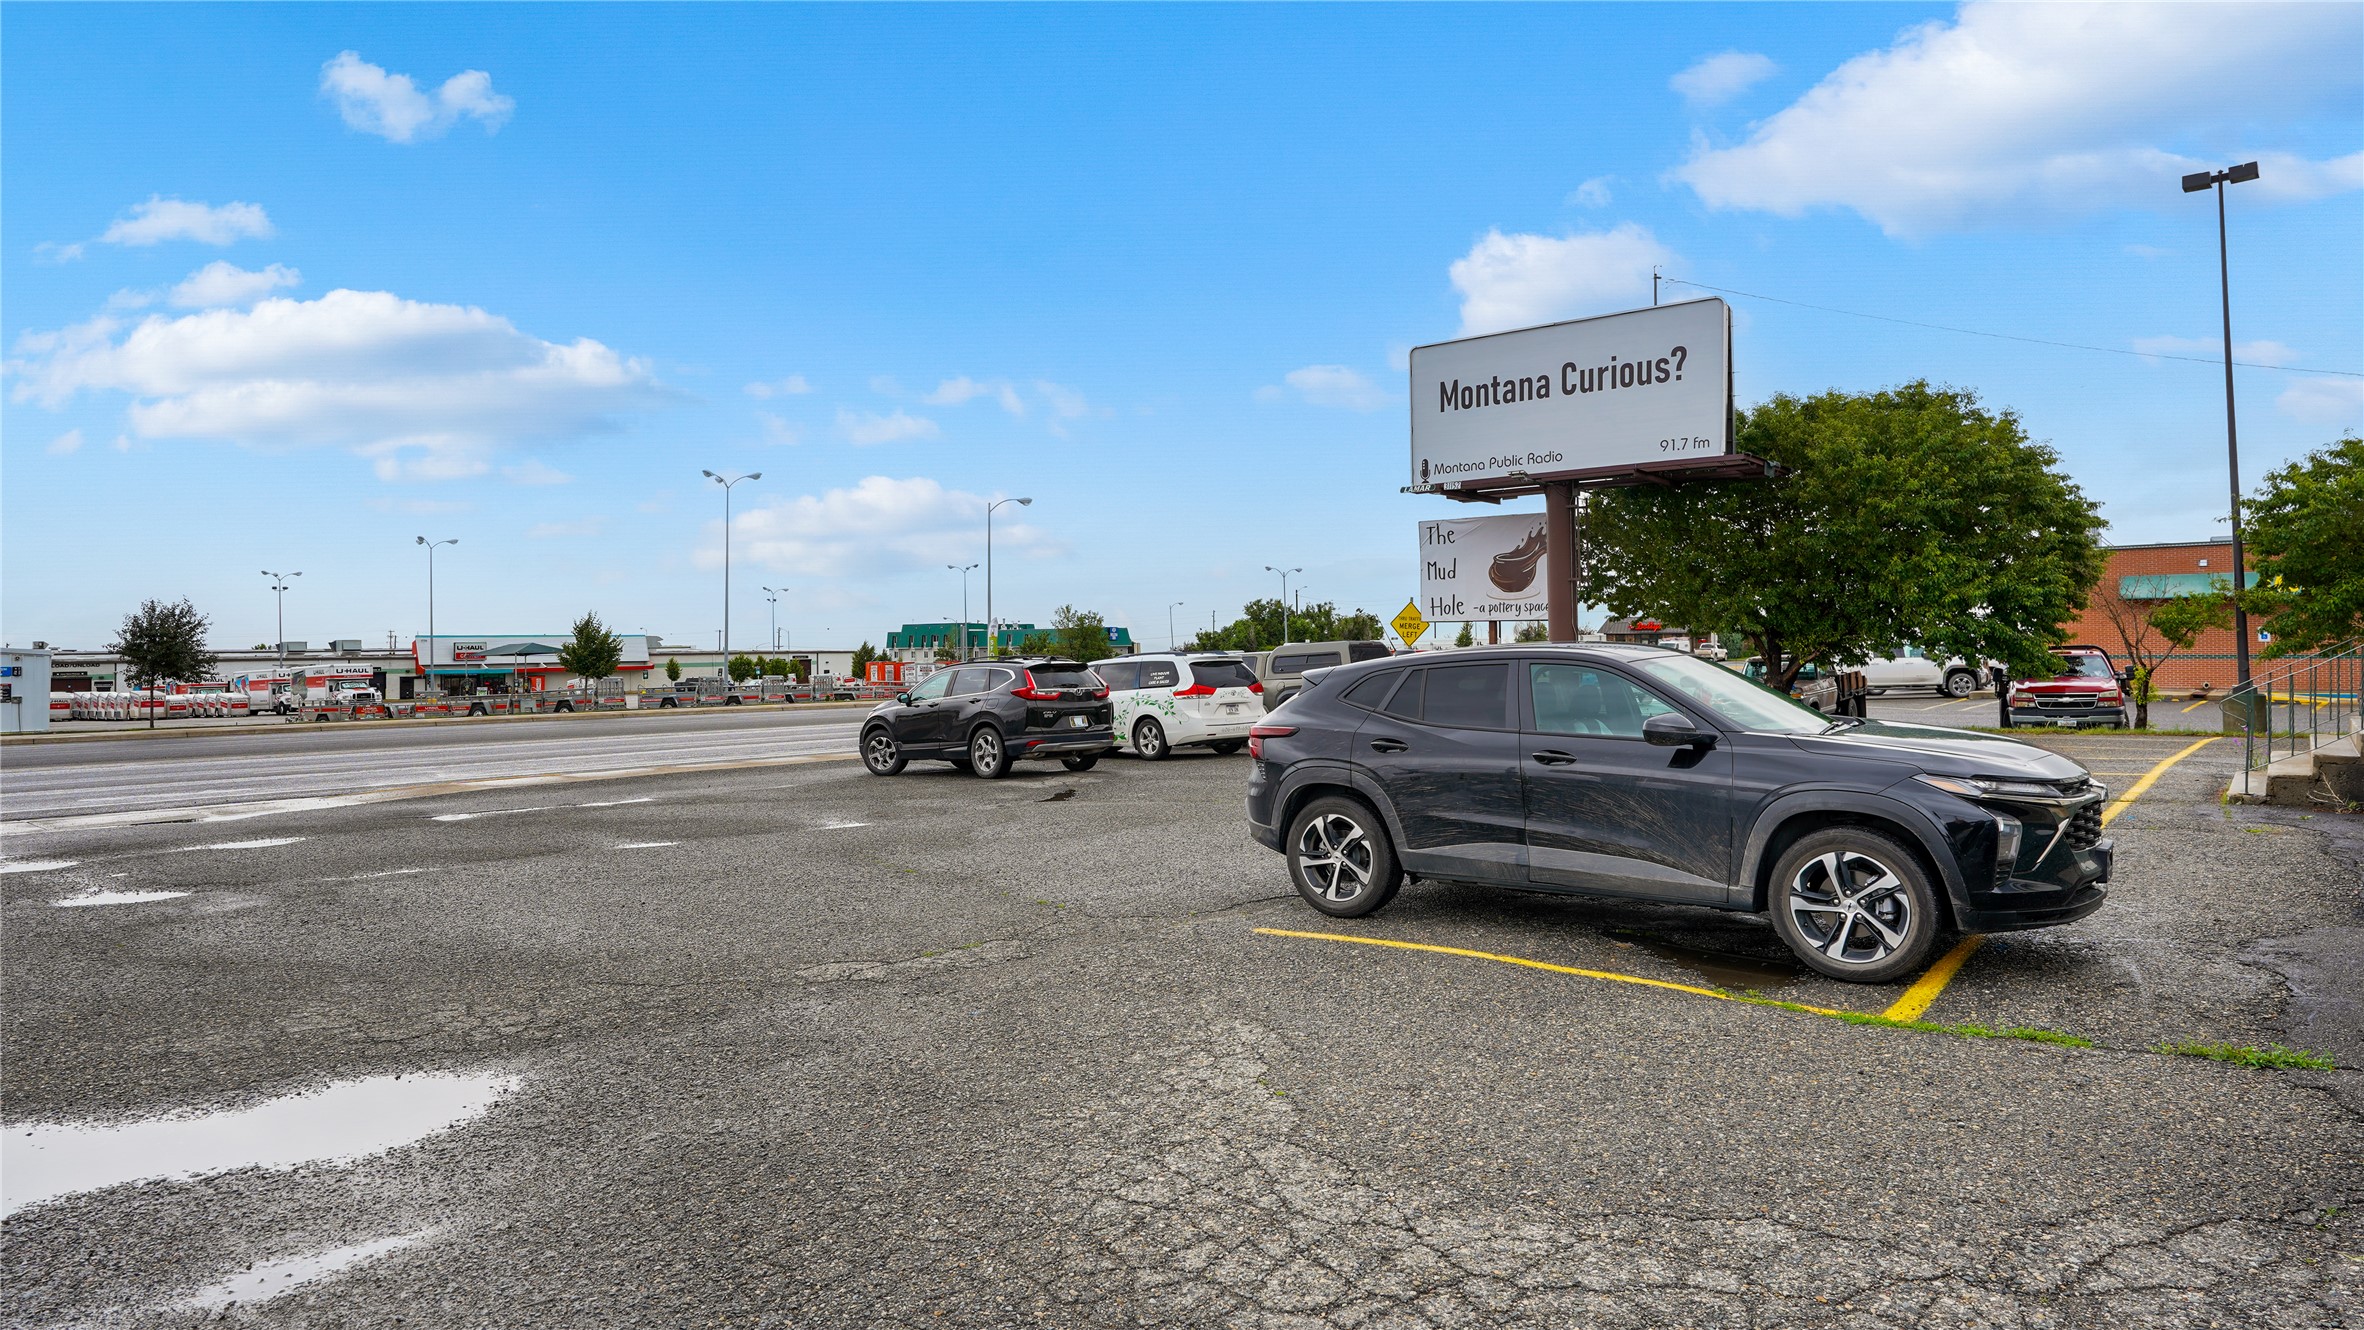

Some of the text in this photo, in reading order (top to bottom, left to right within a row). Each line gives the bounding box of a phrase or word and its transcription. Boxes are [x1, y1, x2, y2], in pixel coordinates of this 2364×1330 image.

[1440, 345, 1688, 413] Montana Curious?
[1660, 436, 1710, 452] 91.7 fm
[1434, 451, 1563, 475] Montana Public Radio
[1403, 484, 1431, 493] LAMAR
[1426, 523, 1456, 545] The
[1427, 557, 1457, 581] Mud
[1430, 594, 1465, 617] Hole
[1488, 601, 1521, 617] pottery
[1399, 622, 1421, 630] MERGE
